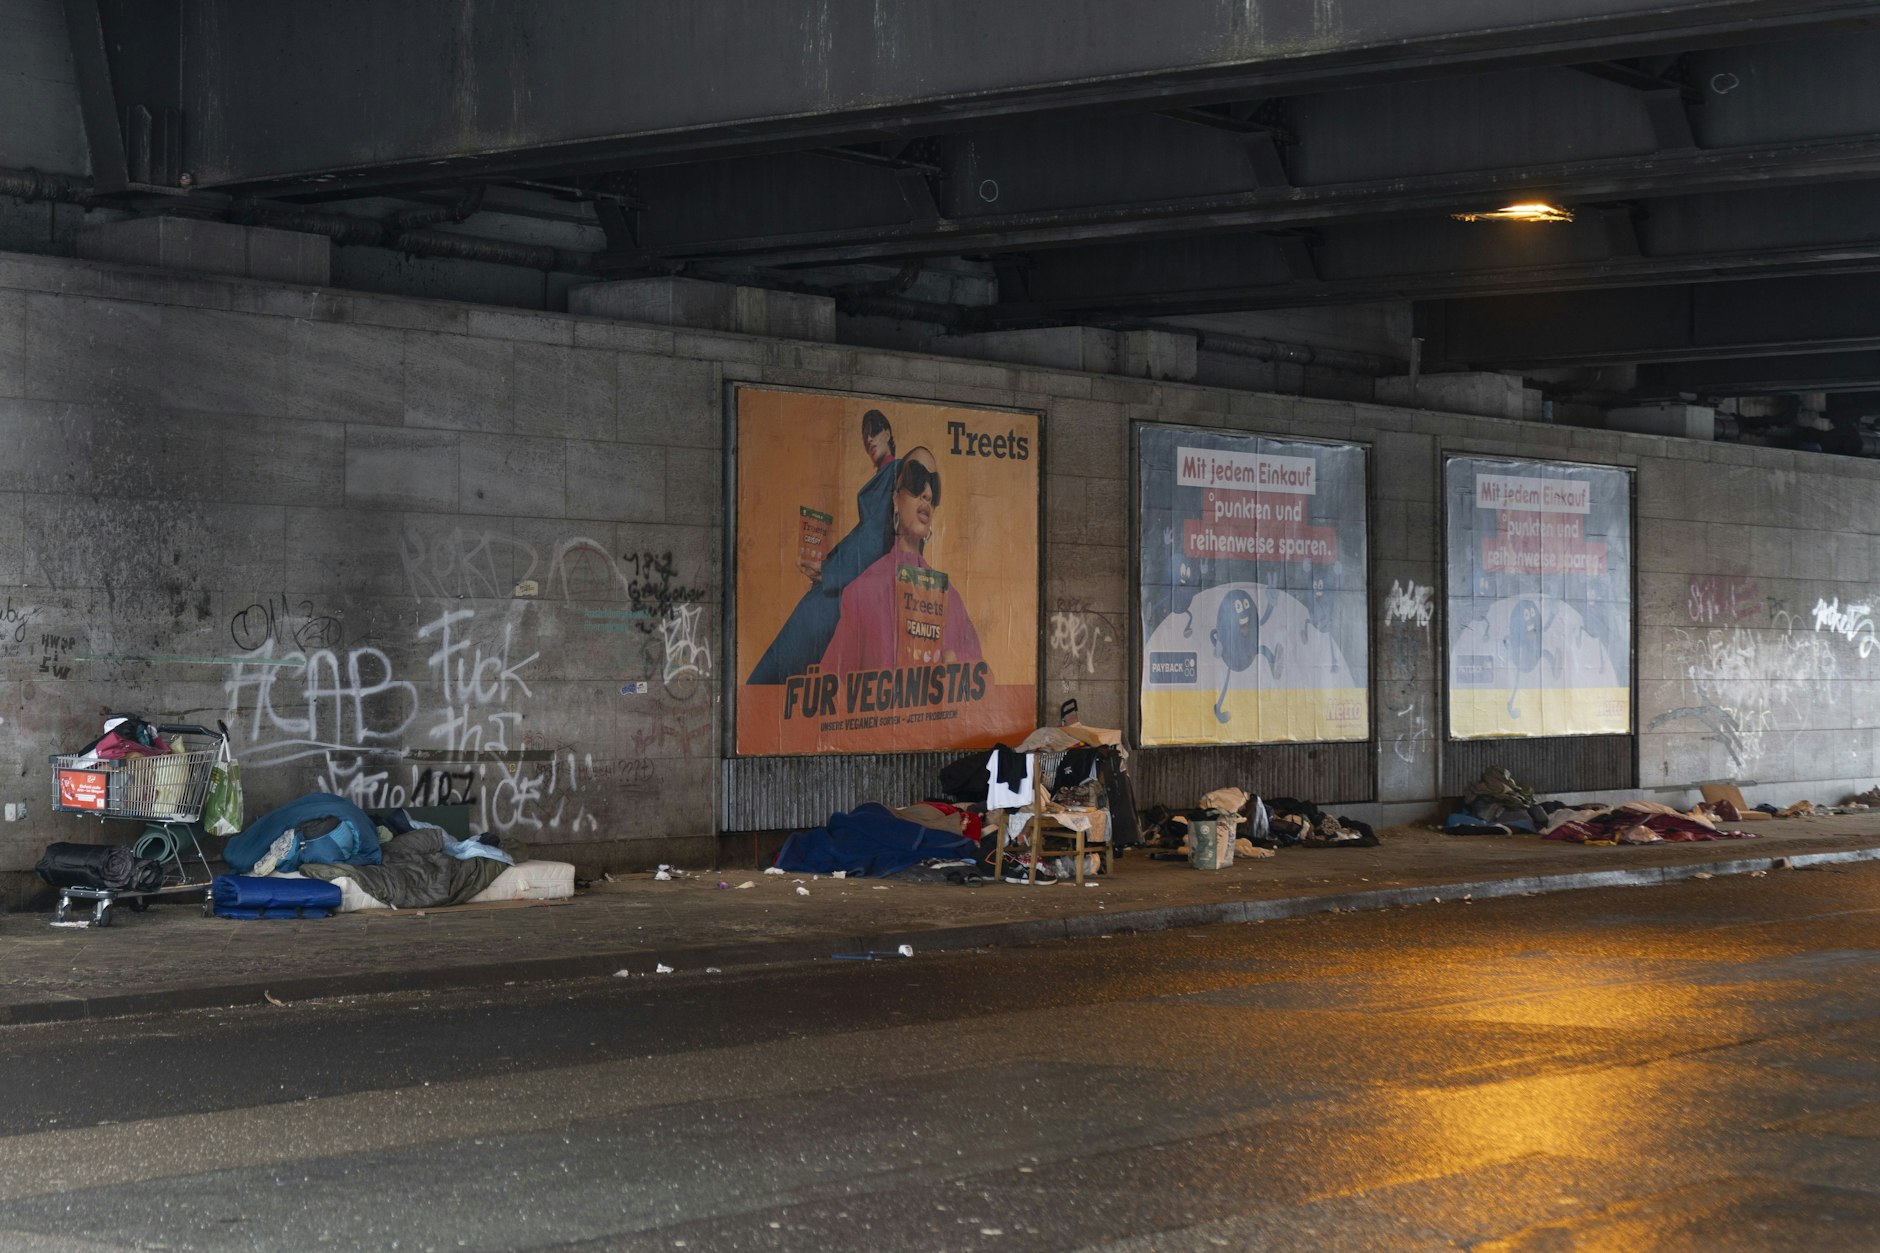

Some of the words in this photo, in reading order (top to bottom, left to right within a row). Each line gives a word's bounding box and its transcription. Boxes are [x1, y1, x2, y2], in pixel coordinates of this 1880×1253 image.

[947, 421, 1029, 460] Treets
[1182, 456, 1206, 479] Mit
[1210, 458, 1255, 484] jedem
[1258, 462, 1311, 487] Einkauf
[1481, 482, 1500, 502] Mit
[1503, 483, 1540, 507] jedem
[1276, 500, 1302, 522] und
[1557, 519, 1579, 539] und
[1190, 528, 1275, 555] reihenweise
[1278, 537, 1332, 560] sparen.
[903, 592, 944, 617] Treets
[907, 620, 941, 639] PEANUTS
[418, 608, 540, 703] Fuck
[1152, 662, 1184, 673] PAYBACK
[783, 666, 838, 720] FÜR
[846, 661, 989, 714] VEGANISTAS
[820, 720, 844, 732] UNSERE
[845, 716, 879, 731] VEGANEN
[906, 713, 925, 724] JETZT
